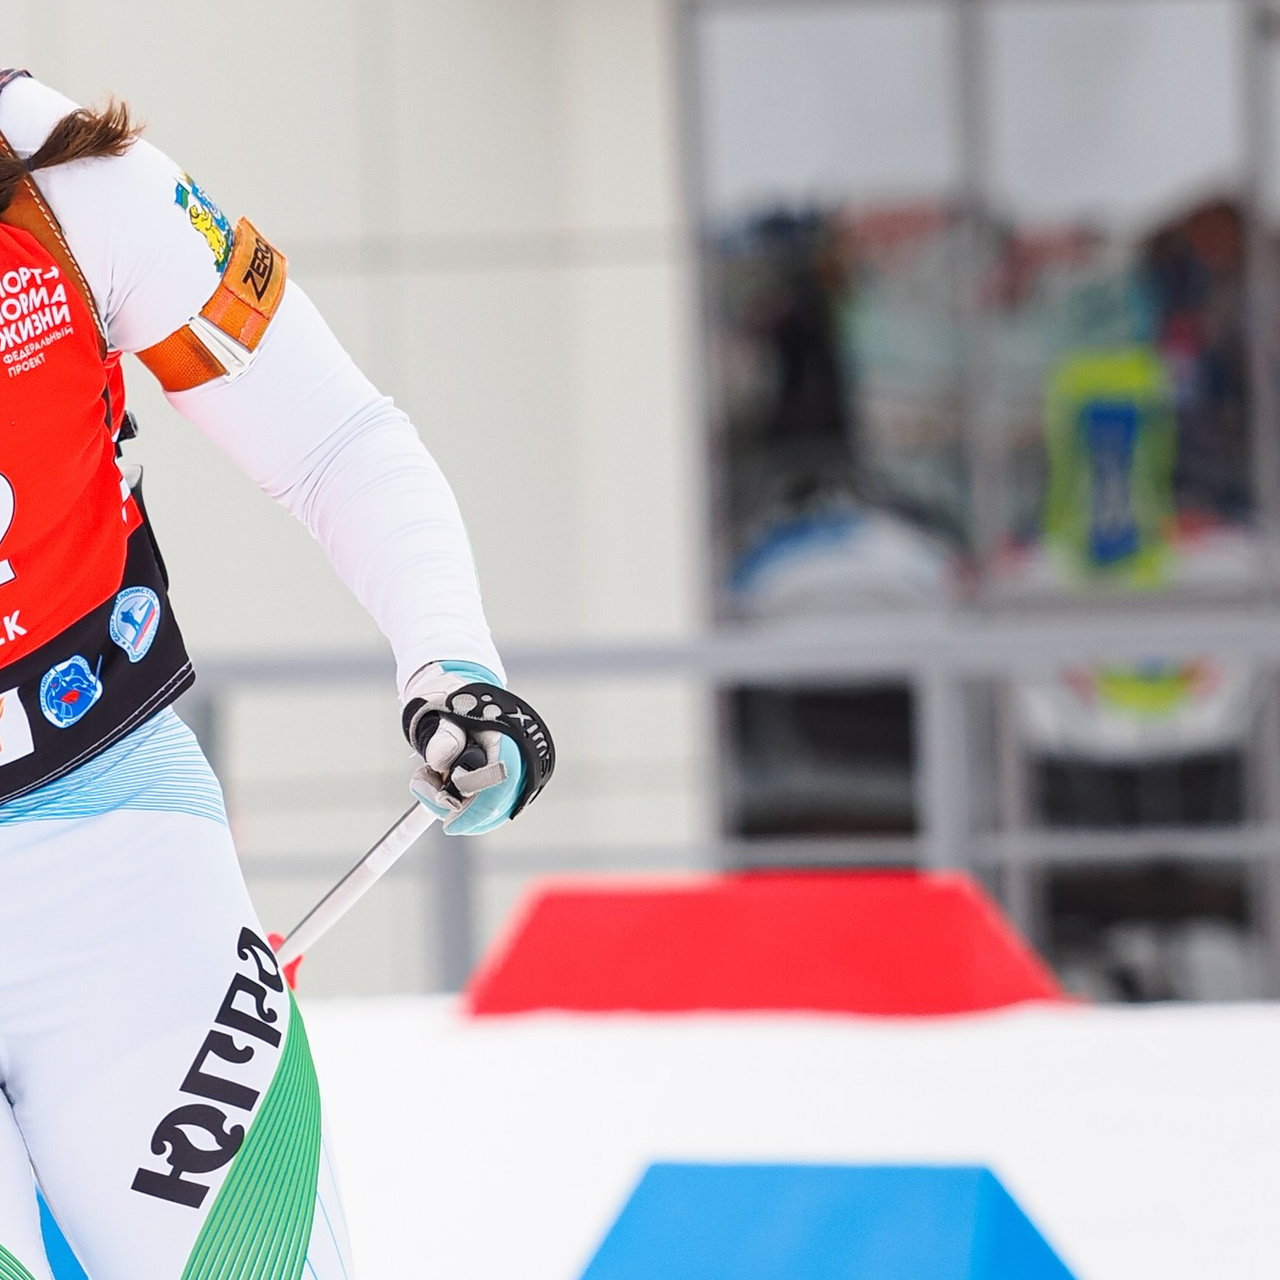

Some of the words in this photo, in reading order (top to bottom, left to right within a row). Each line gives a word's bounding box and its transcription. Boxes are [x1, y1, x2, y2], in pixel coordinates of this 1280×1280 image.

[242, 237, 274, 302] ZERO
[3, 325, 74, 364] ФЕДЕРАЛЬНЫЙ
[8, 353, 46, 378] ПРОЕКТ
